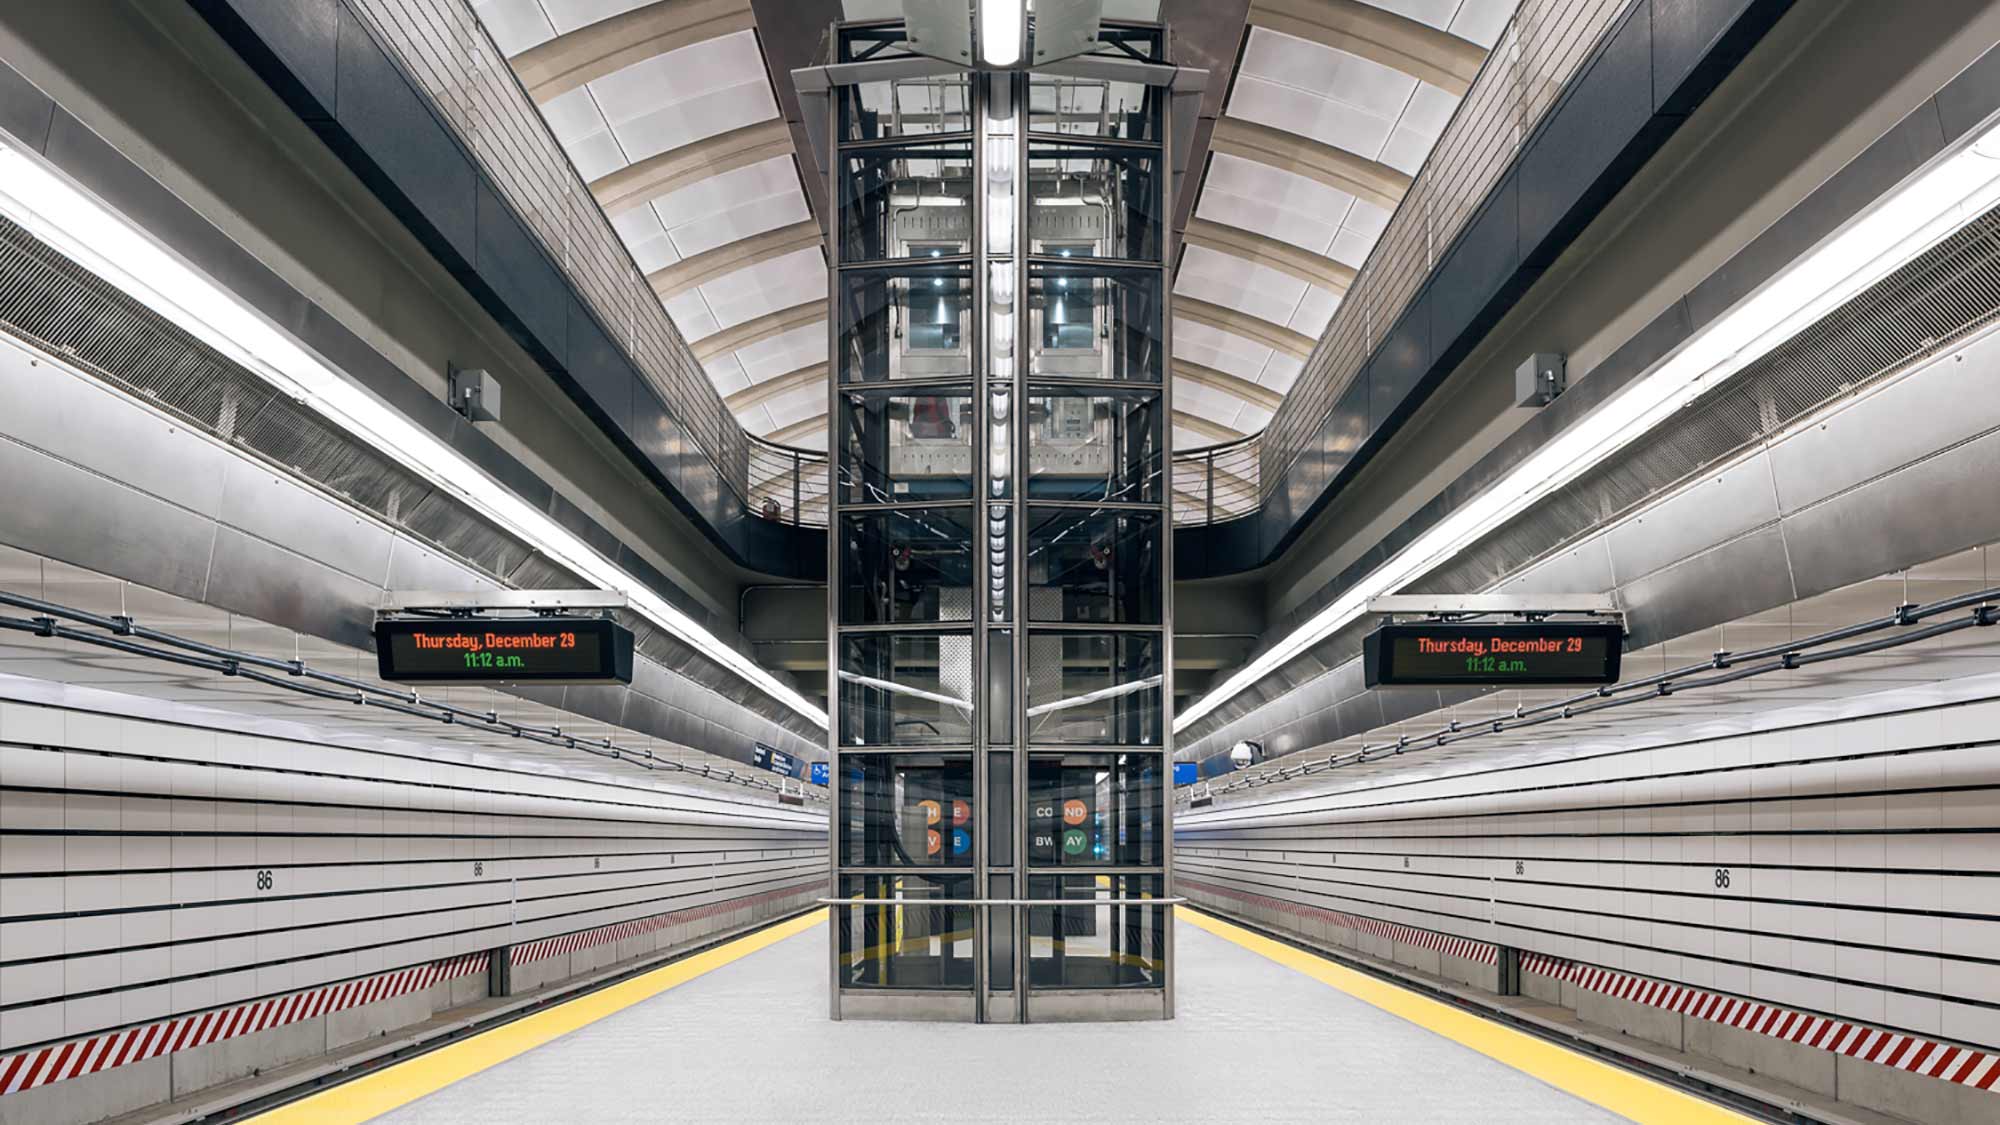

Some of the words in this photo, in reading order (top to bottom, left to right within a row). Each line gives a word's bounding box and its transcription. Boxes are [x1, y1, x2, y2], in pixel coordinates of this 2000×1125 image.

[413, 632, 483, 651] Thursday,
[485, 632, 556, 648] December
[560, 632, 575, 648] 29
[1417, 637, 1487, 655] Thursday,
[1491, 637, 1562, 653] December
[1567, 637, 1582, 652] 29
[463, 653, 493, 667] 11:12
[496, 655, 525, 667] a.m.
[1466, 657, 1495, 672] 11:12
[1498, 659, 1527, 671] a.m.
[474, 861, 483, 876] 86
[1515, 860, 1524, 875] 86
[257, 870, 273, 890] 86
[1715, 868, 1730, 888] 86
